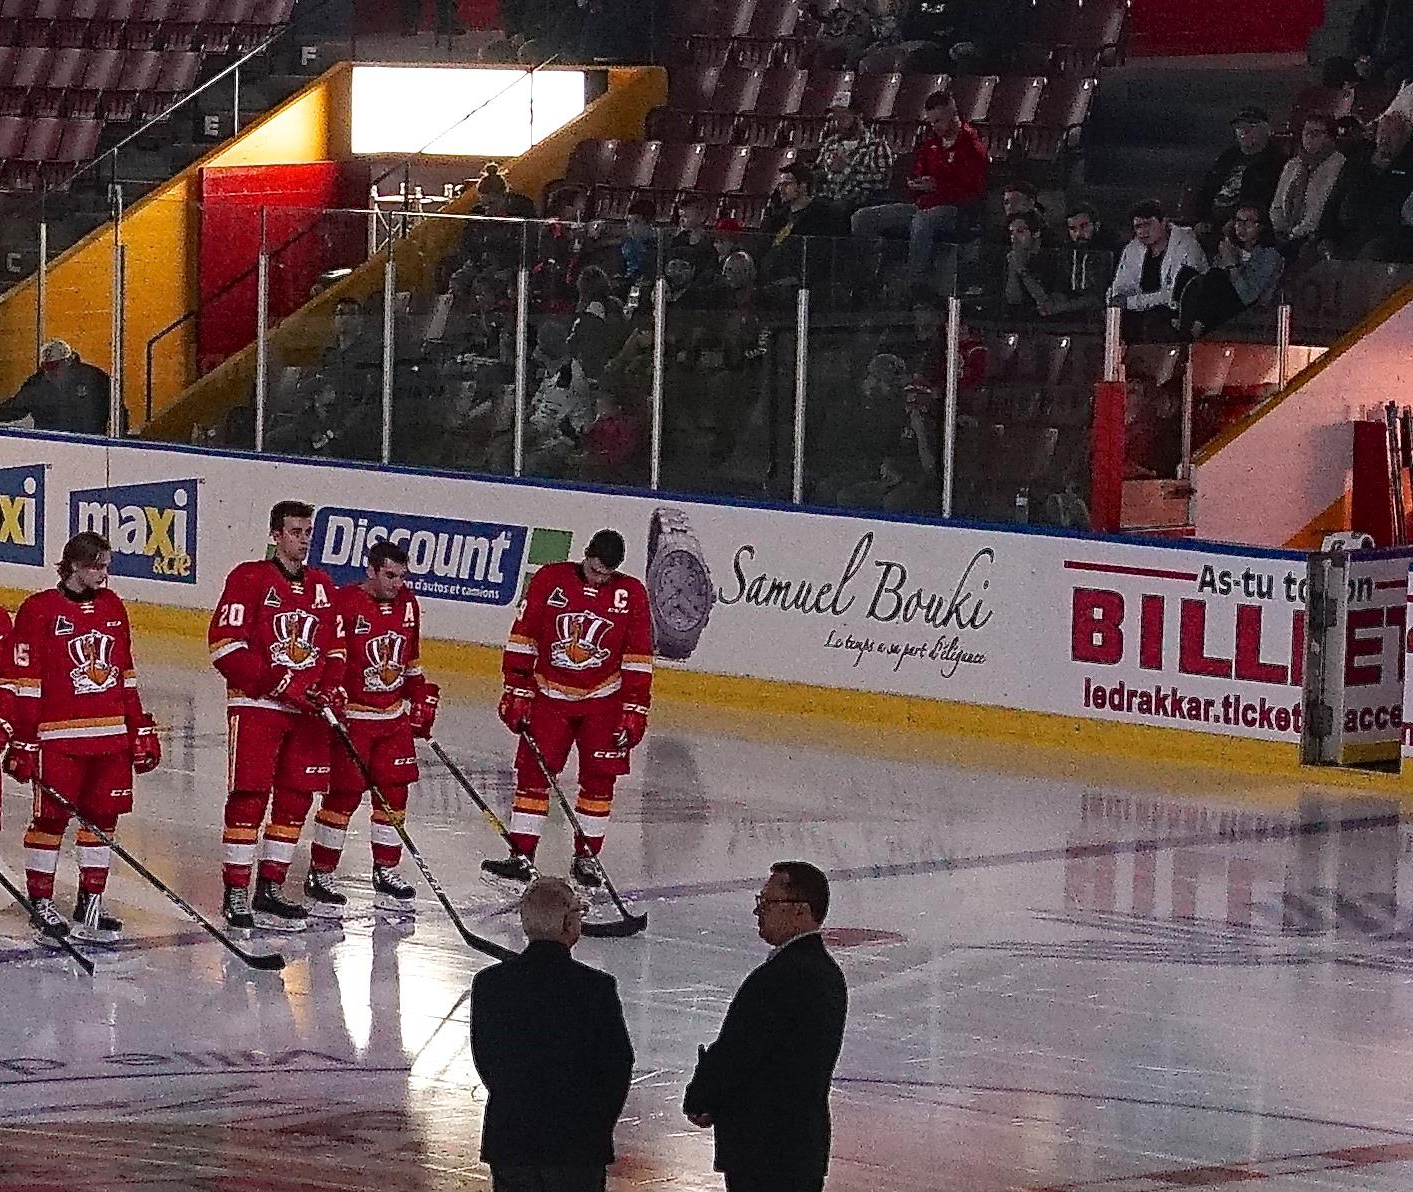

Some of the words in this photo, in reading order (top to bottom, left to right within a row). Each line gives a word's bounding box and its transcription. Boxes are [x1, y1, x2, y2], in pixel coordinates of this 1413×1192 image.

[204, 115, 221, 136] E
[78, 488, 189, 556] maxi
[415, 578, 448, 593] d'autos
[450, 583, 461, 595] et
[718, 531, 856, 616] Samuel
[865, 547, 995, 630] Bouki
[1198, 564, 1274, 600] As-tu
[313, 583, 330, 604] A
[613, 588, 629, 608] C
[218, 602, 245, 627] 20
[403, 602, 415, 621] A
[393, 757, 415, 766] CC
[110, 788, 133, 798] CC
